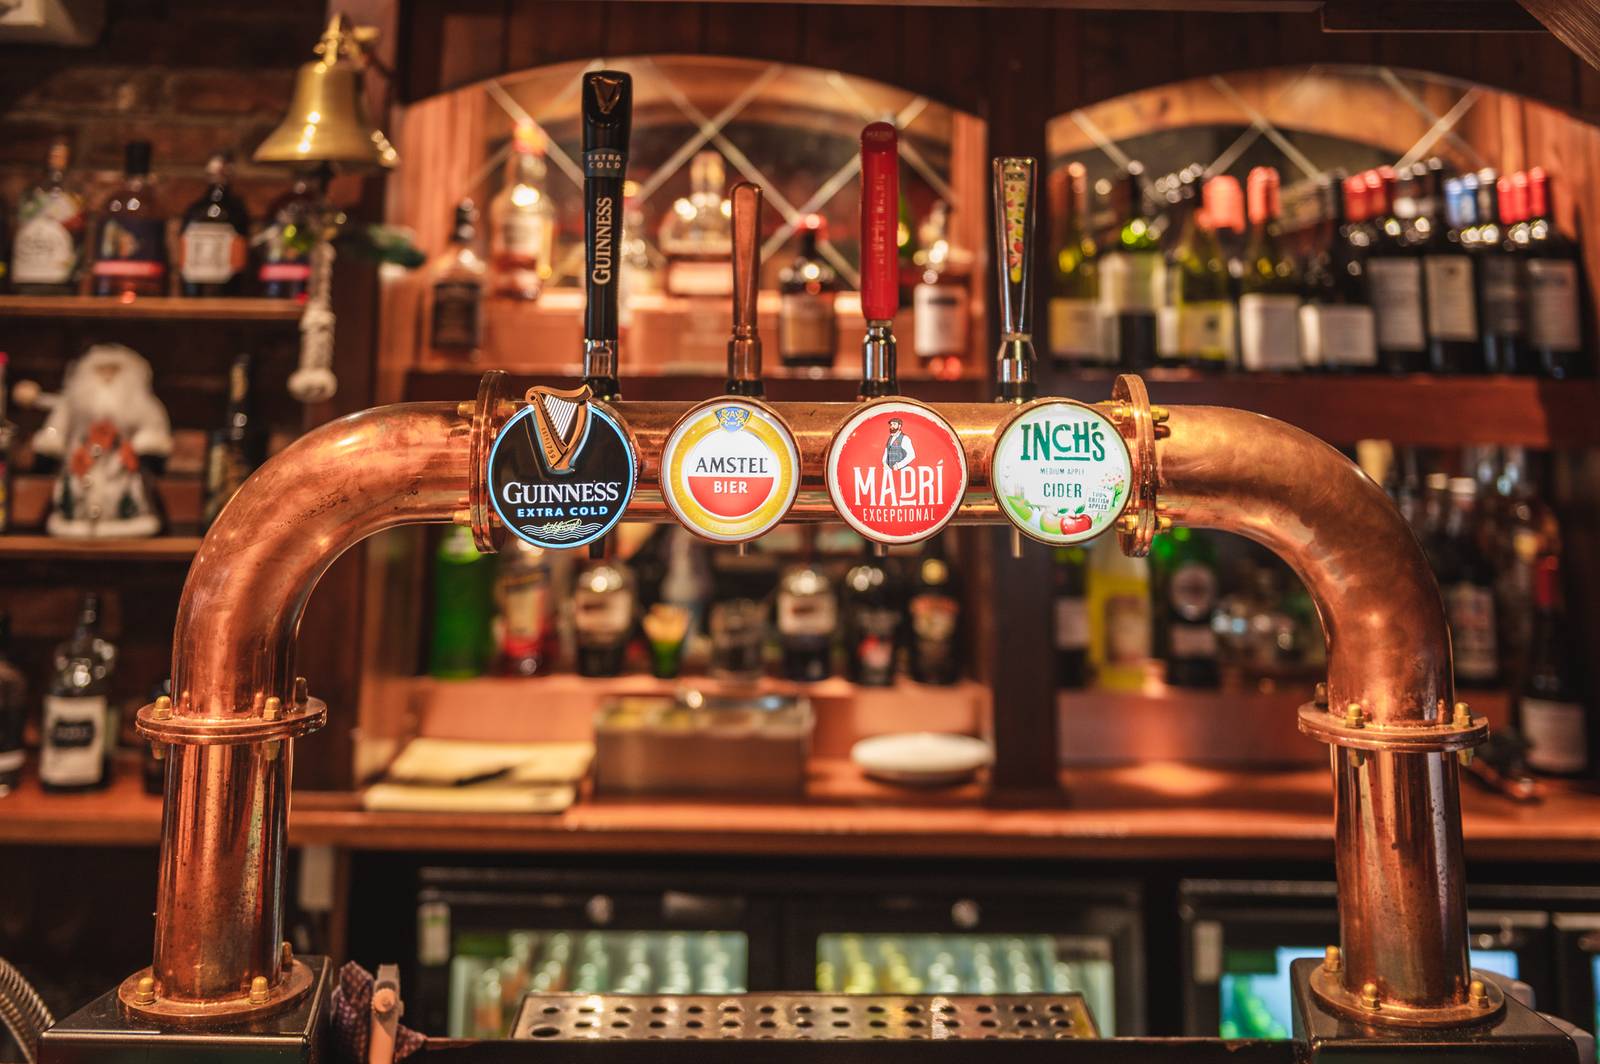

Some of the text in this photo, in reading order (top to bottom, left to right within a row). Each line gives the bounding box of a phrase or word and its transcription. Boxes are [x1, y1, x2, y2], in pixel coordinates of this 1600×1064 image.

[588, 161, 621, 169] COLD
[592, 197, 612, 285] GUINNESS
[1020, 420, 1105, 462] INCH'S
[695, 456, 768, 474] AMSTEL
[1040, 467, 1085, 476] MEDIUM APPLE
[713, 480, 748, 494] BIER
[853, 459, 944, 506] MADRÍ
[1043, 482, 1082, 498] CIDER
[502, 481, 619, 504] GUINNESS
[517, 506, 609, 517] EXTRA COLD
[863, 507, 935, 522] EXCEPCIONAL
